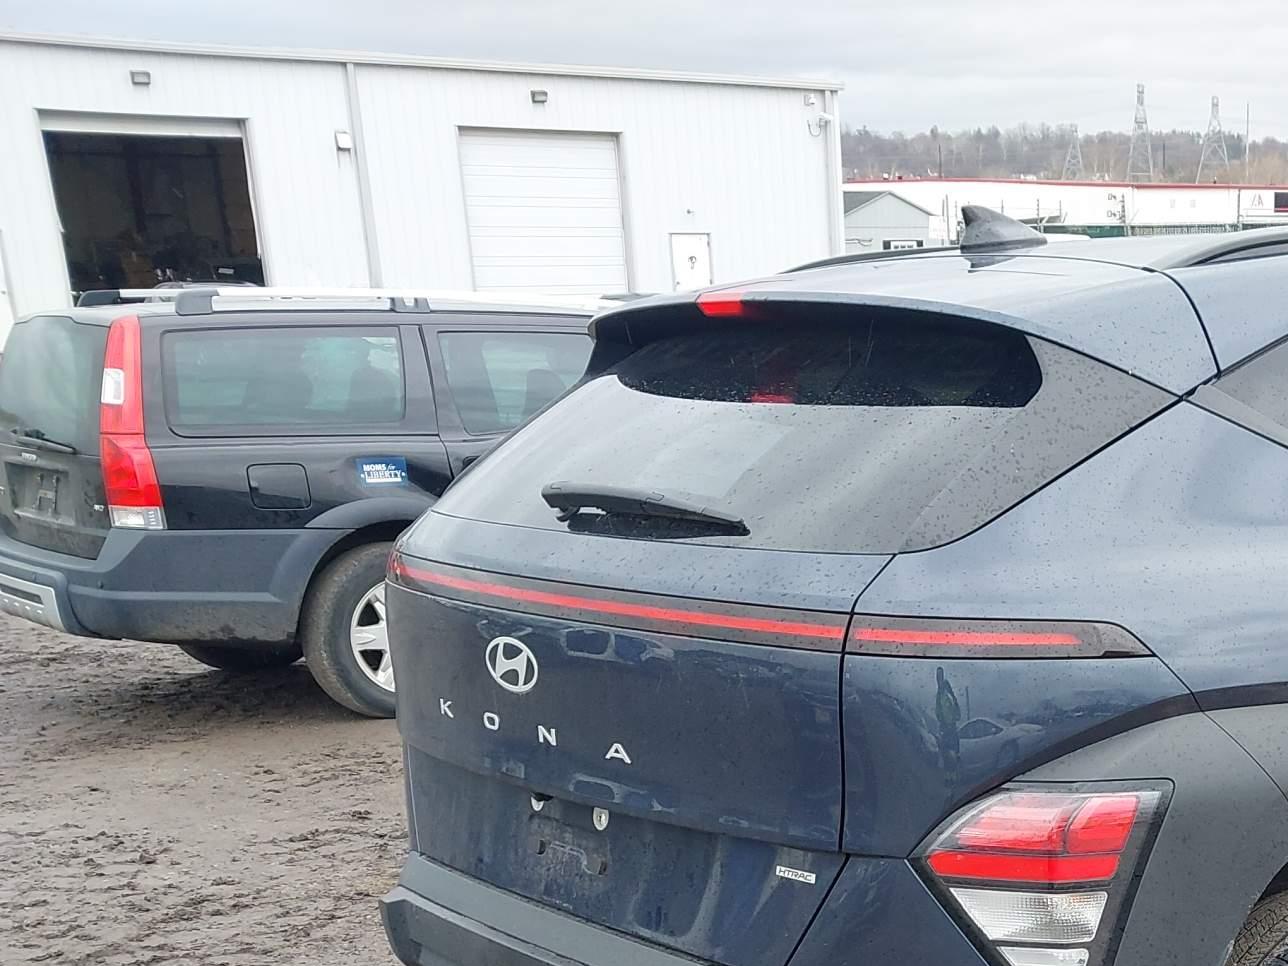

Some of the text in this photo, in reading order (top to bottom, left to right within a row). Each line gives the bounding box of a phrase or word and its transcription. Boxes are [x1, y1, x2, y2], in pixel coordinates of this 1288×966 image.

[363, 463, 387, 471] MOMS
[364, 470, 401, 479] LIBERTY
[439, 698, 632, 765] KONA
[778, 867, 813, 882] HTRAC
